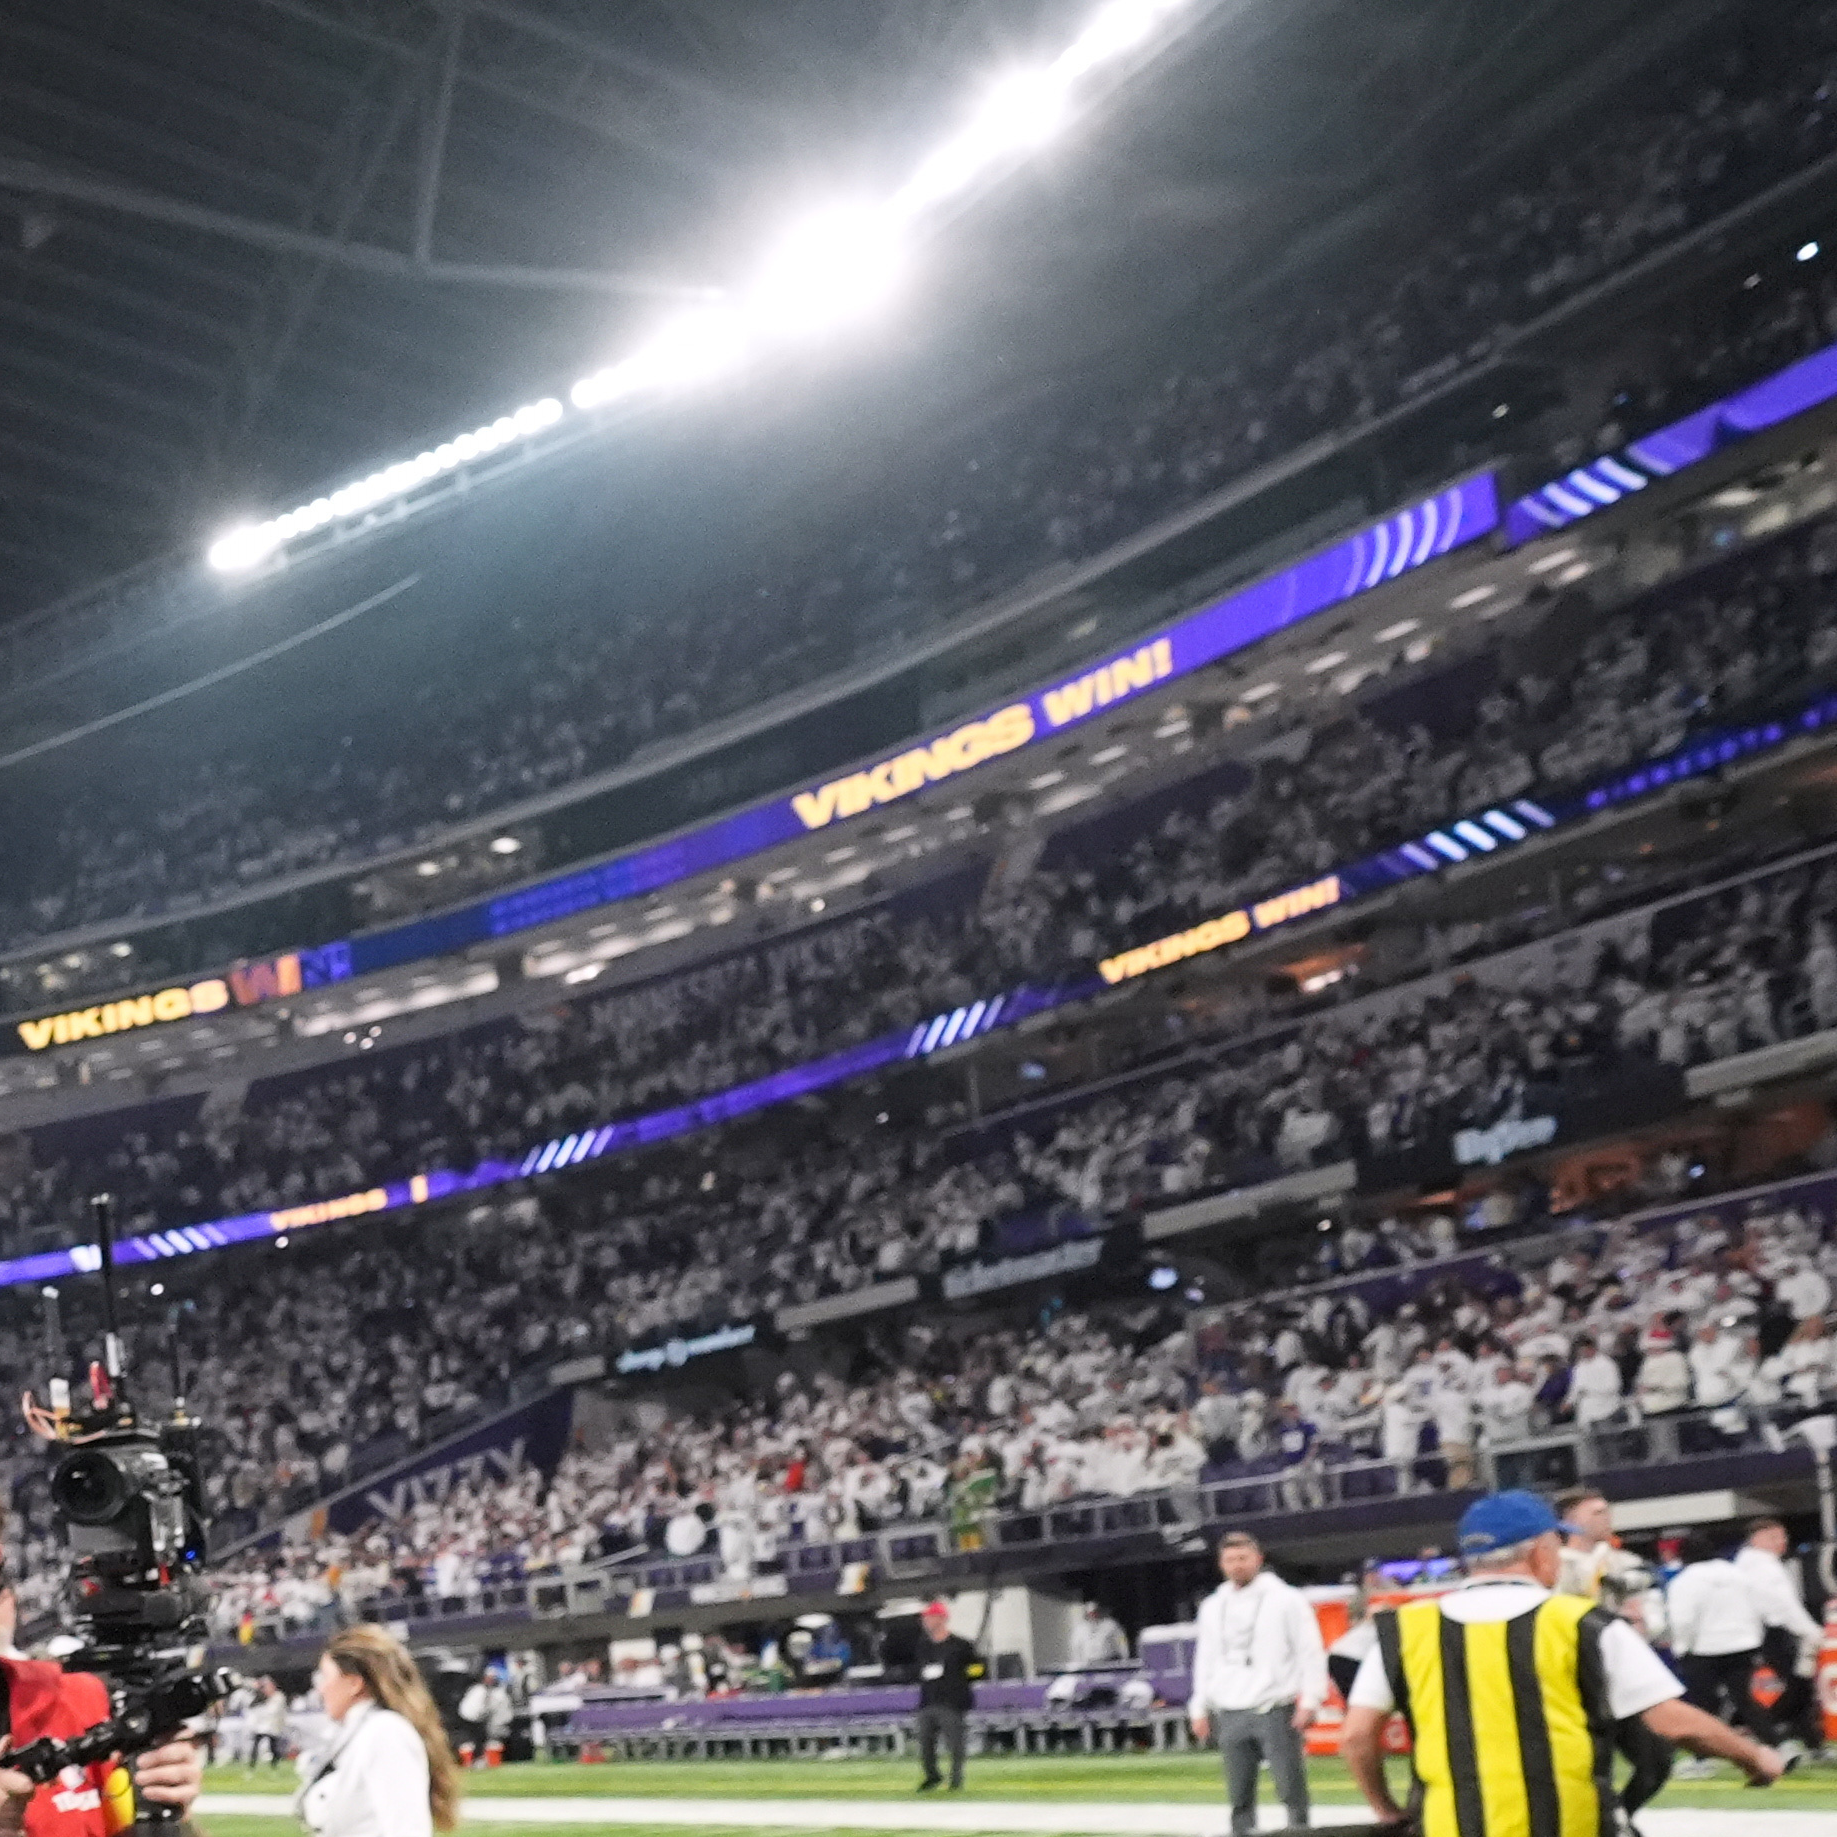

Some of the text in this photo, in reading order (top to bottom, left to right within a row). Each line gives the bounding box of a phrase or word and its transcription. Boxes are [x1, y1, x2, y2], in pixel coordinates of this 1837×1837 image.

[792, 637, 1173, 829] VIKINGS WIN!
[1098, 909, 1251, 985] VIKINGS
[18, 979, 228, 1050] VIKINGS
